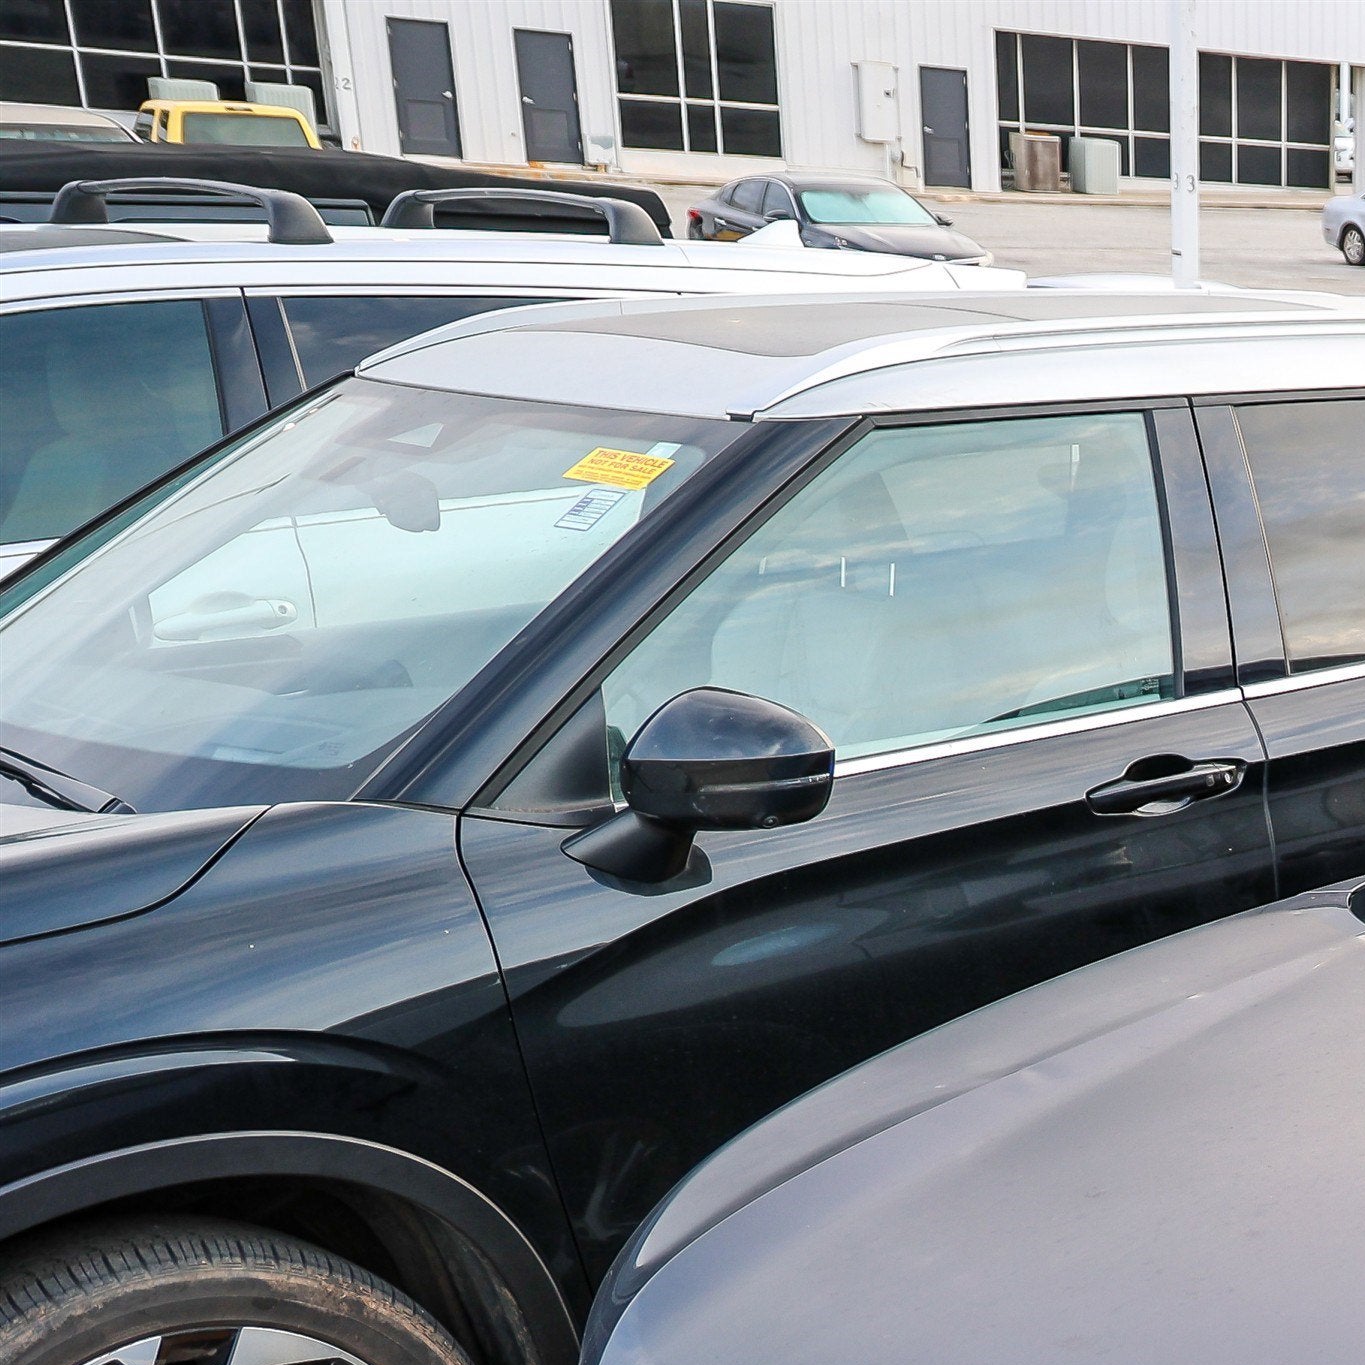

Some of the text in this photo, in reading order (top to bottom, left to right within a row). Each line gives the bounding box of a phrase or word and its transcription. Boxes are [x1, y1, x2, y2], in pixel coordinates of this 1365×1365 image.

[1186, 174, 1195, 192] 3
[588, 458, 607, 467] NOT
[609, 461, 631, 470] FOR
[629, 465, 657, 475] SALE
[594, 450, 669, 469] THIS VEHICLE
